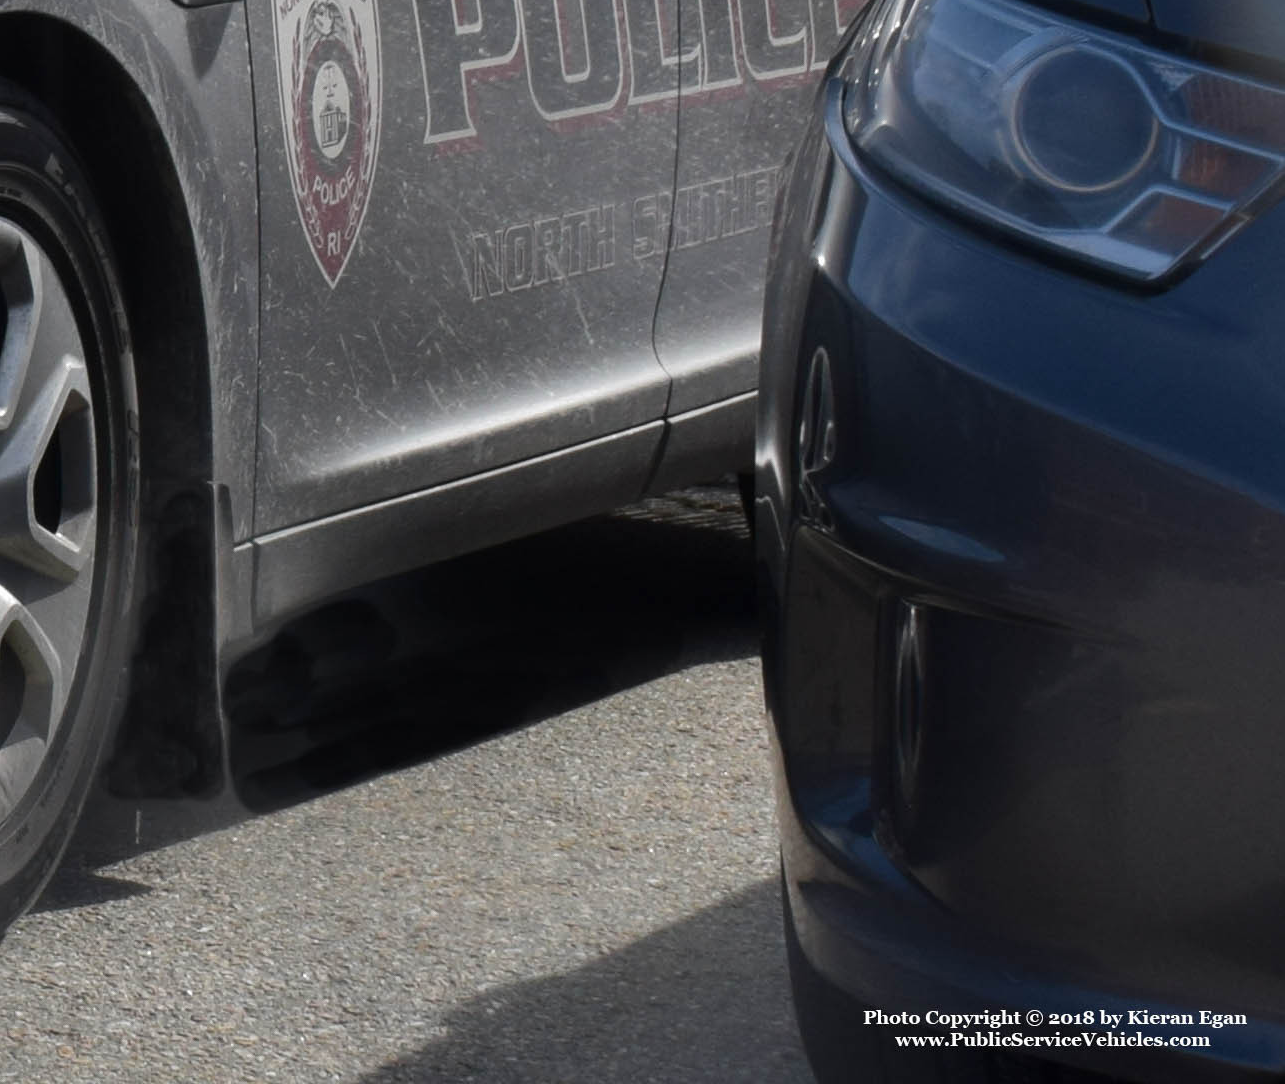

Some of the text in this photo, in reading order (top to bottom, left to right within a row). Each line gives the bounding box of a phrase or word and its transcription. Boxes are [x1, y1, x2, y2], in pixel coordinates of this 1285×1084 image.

[312, 166, 355, 204] POLICE
[327, 232, 341, 256] RI
[471, 204, 615, 302] NORTH
